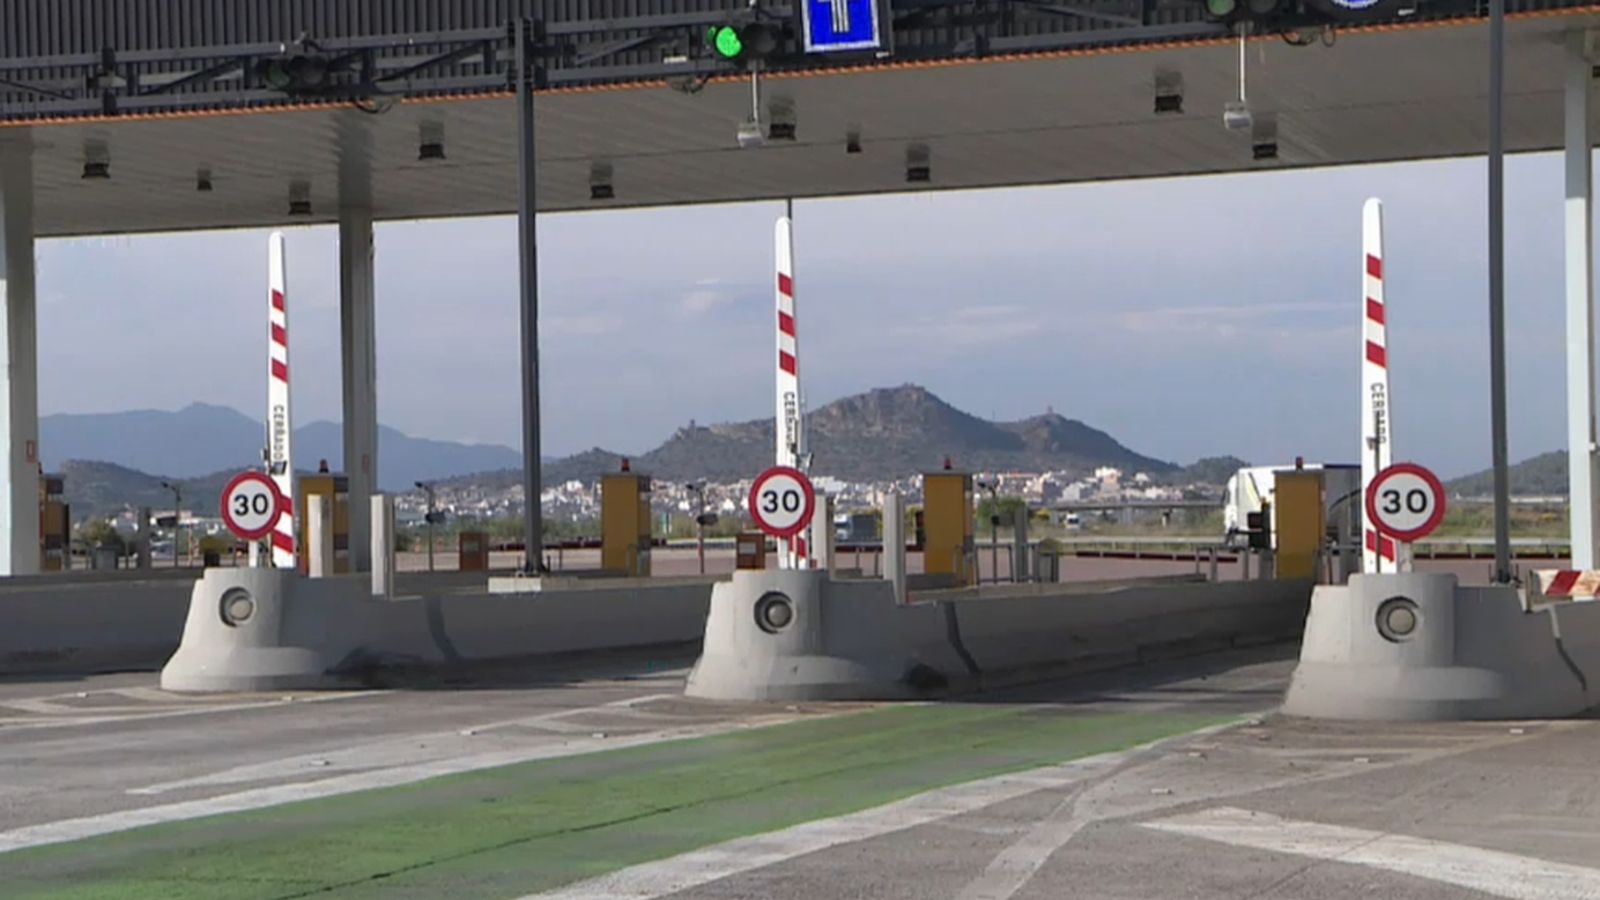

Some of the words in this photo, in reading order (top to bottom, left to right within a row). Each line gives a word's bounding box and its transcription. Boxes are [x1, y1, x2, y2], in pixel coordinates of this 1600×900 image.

[234, 493, 269, 517] 30
[762, 489, 800, 514] 30
[1382, 489, 1427, 514] 30
